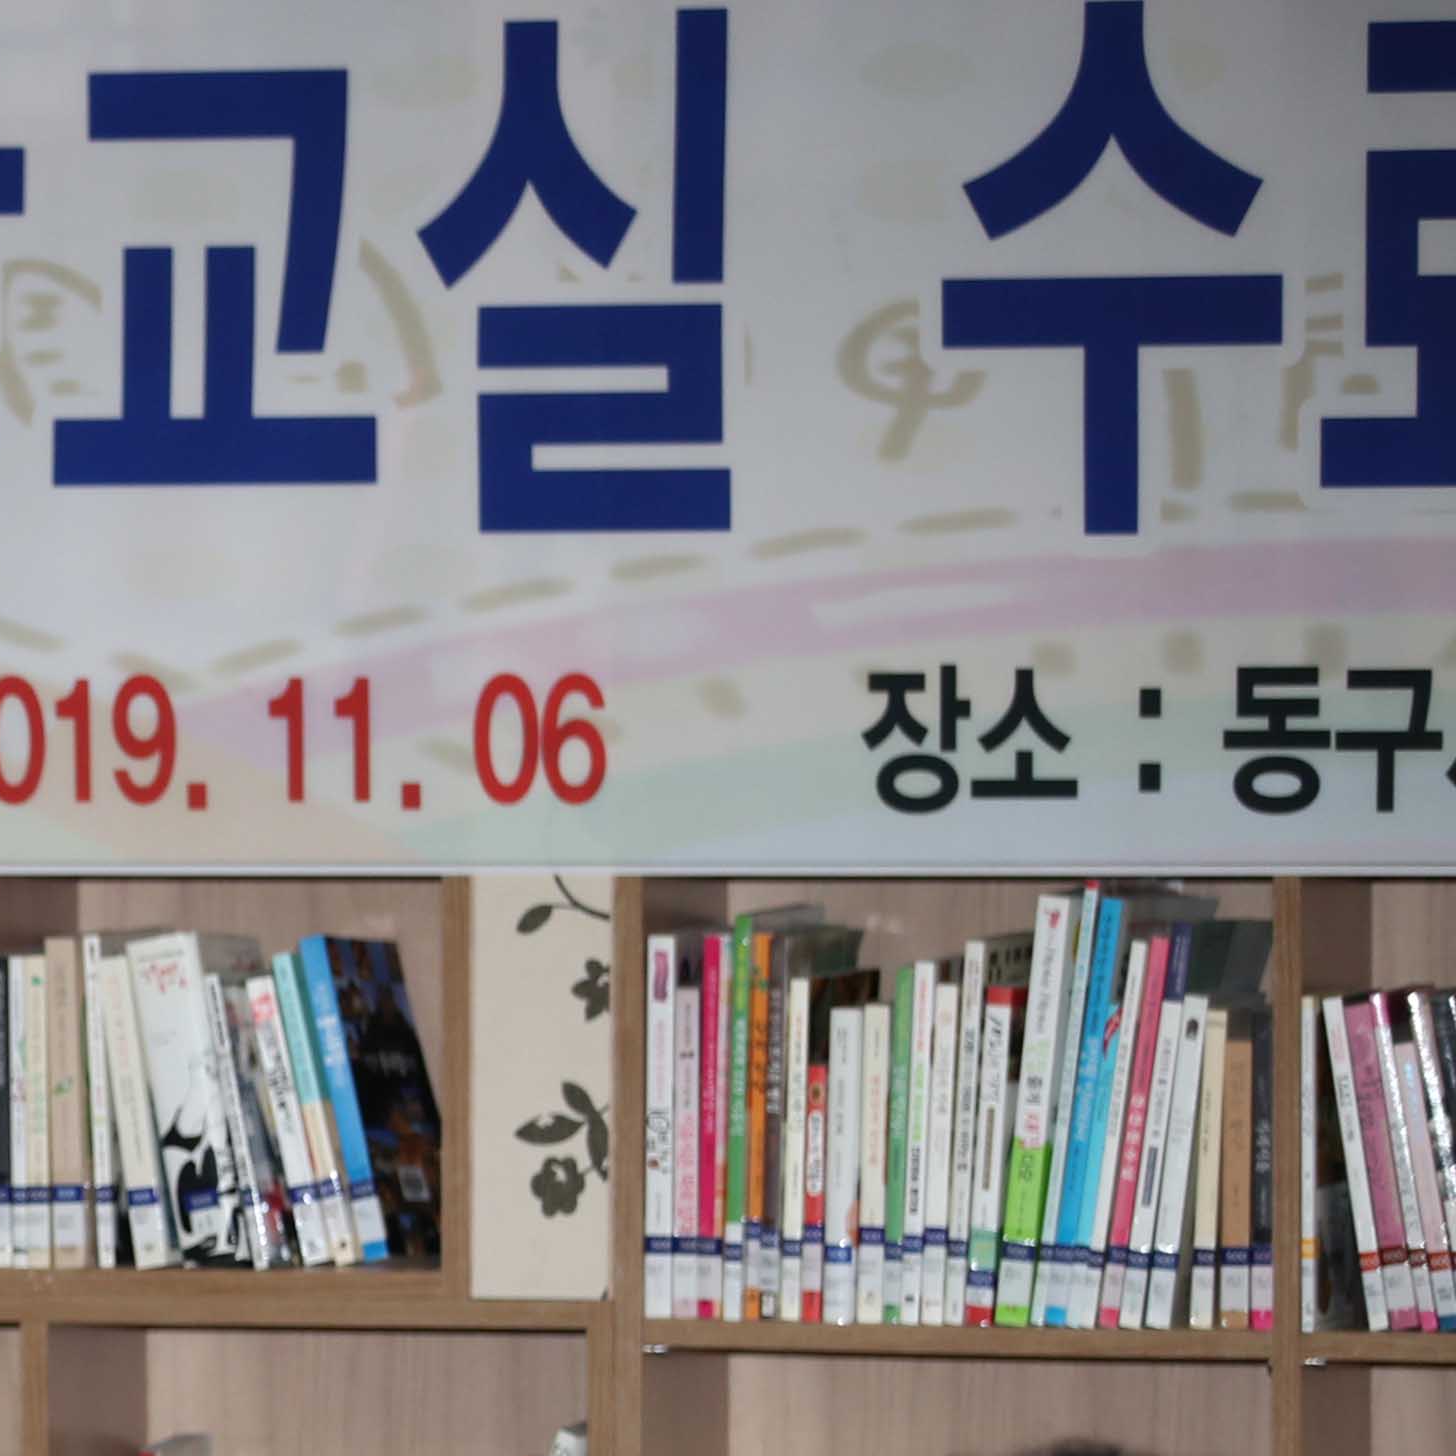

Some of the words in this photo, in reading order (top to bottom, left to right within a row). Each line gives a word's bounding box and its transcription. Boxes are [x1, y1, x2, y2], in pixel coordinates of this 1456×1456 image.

[267, 676, 422, 810] 11.
[473, 671, 608, 805] 06
[861, 663, 1079, 815] 장소
[1222, 665, 1456, 815] 동구
